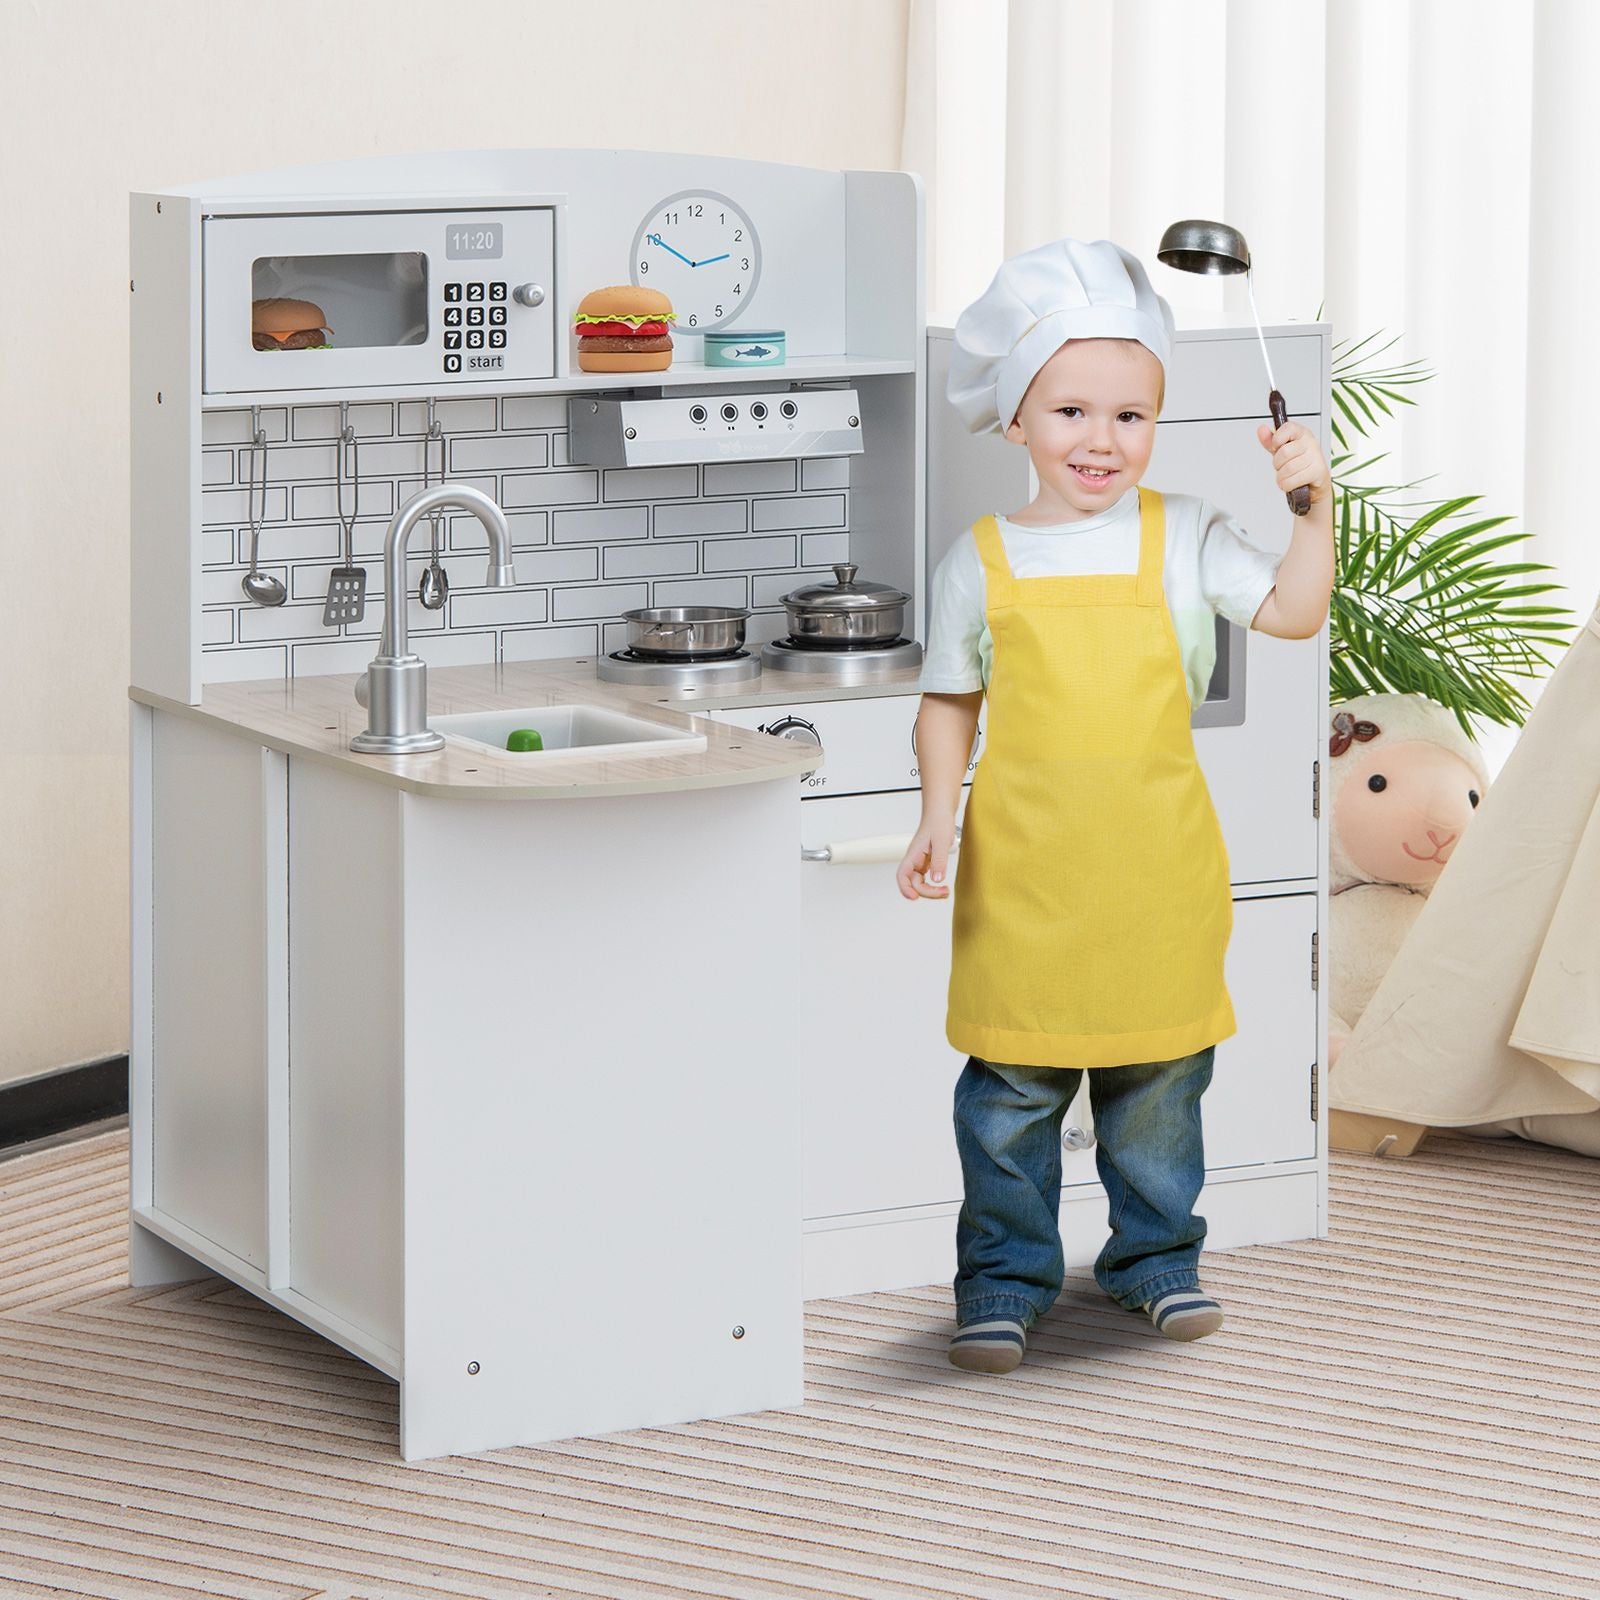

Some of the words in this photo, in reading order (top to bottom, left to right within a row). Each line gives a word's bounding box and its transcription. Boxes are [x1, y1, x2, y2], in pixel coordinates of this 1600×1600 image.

[687, 204, 703, 217] 12
[665, 212, 678, 225] 11
[719, 212, 725, 225] 1
[453, 231, 494, 250] 11:20
[645, 233, 661, 246] 10
[734, 229, 743, 242] 2
[640, 261, 649, 274] 9
[741, 258, 749, 271] 3
[449, 286, 458, 300] 1
[470, 286, 481, 300] 2
[493, 285, 504, 299] 3
[733, 283, 741, 295] 4
[447, 309, 459, 324] 4
[470, 309, 481, 323] 5
[492, 308, 504, 322] 6
[715, 304, 723, 317] 5
[689, 314, 697, 327] 6
[447, 333, 458, 348] 7
[469, 332, 481, 347] 8
[492, 332, 504, 346] 9
[447, 356, 459, 371] 0
[470, 355, 503, 368] start
[808, 777, 827, 787] OFF
